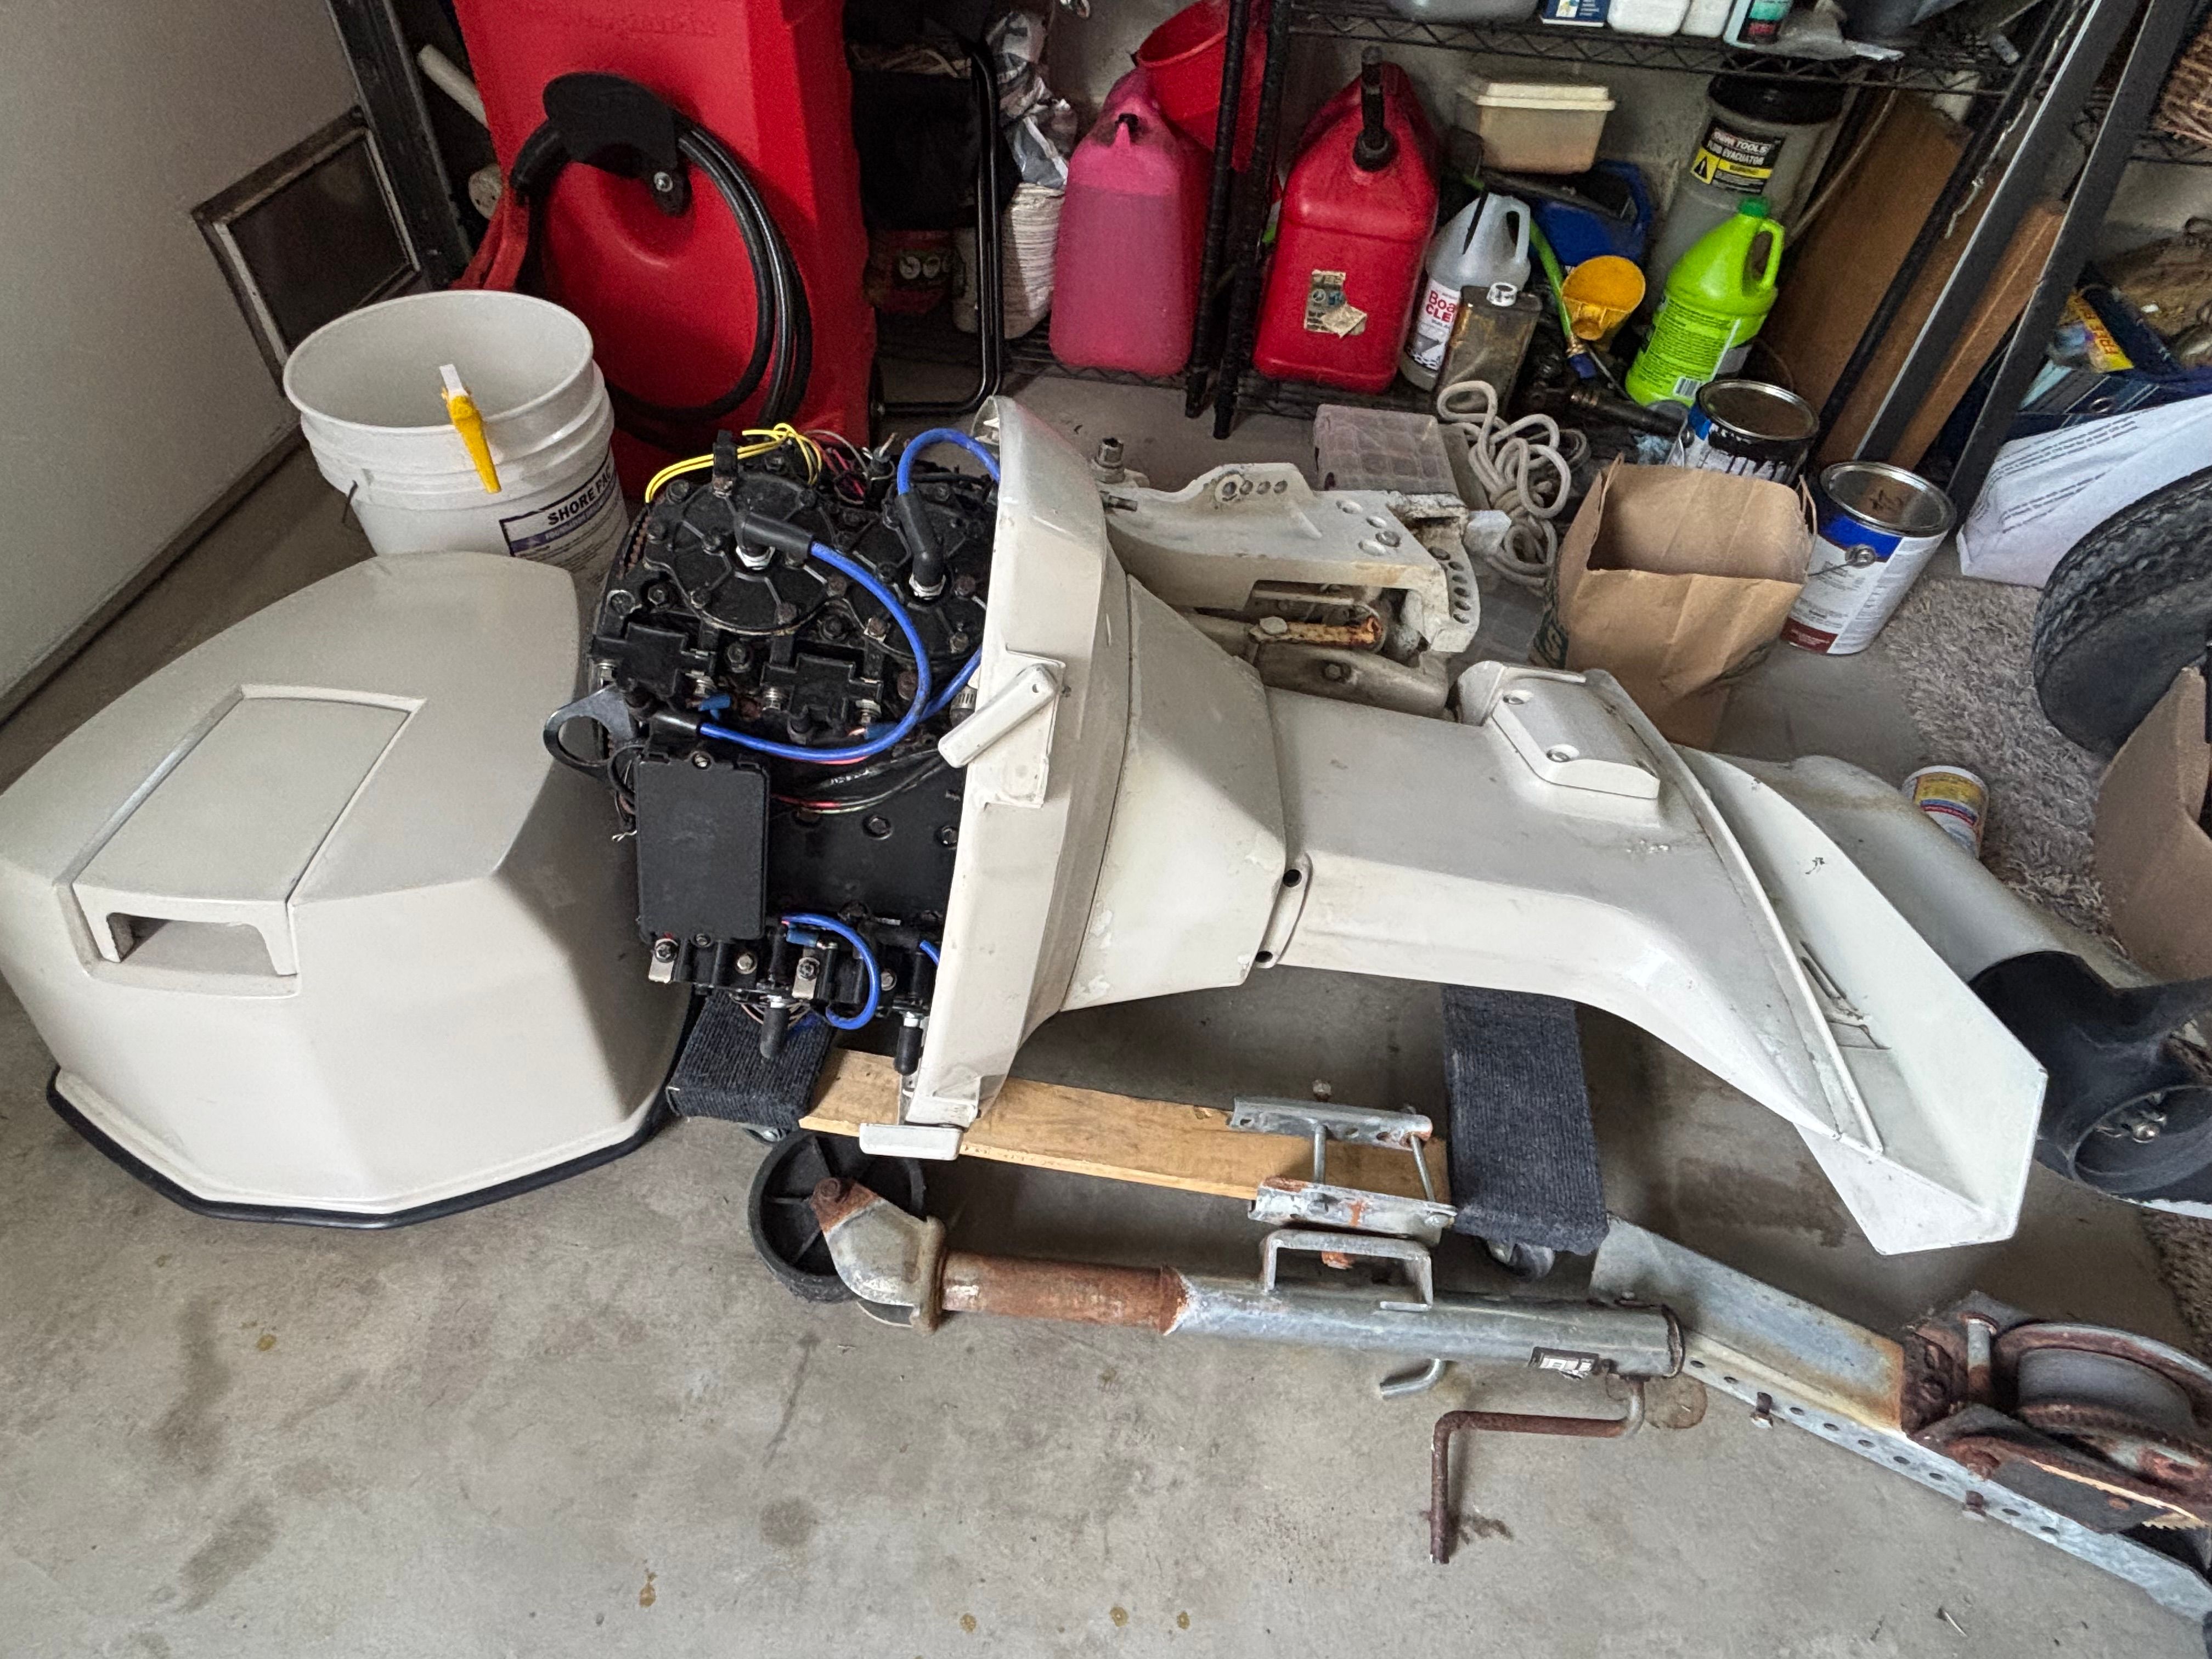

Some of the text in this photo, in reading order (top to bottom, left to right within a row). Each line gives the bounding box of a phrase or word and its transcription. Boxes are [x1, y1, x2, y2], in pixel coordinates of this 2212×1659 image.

[1722, 148, 1765, 165] EVACUATOR
[1426, 304, 1455, 322] CLE
[548, 486, 595, 525] SHORE
